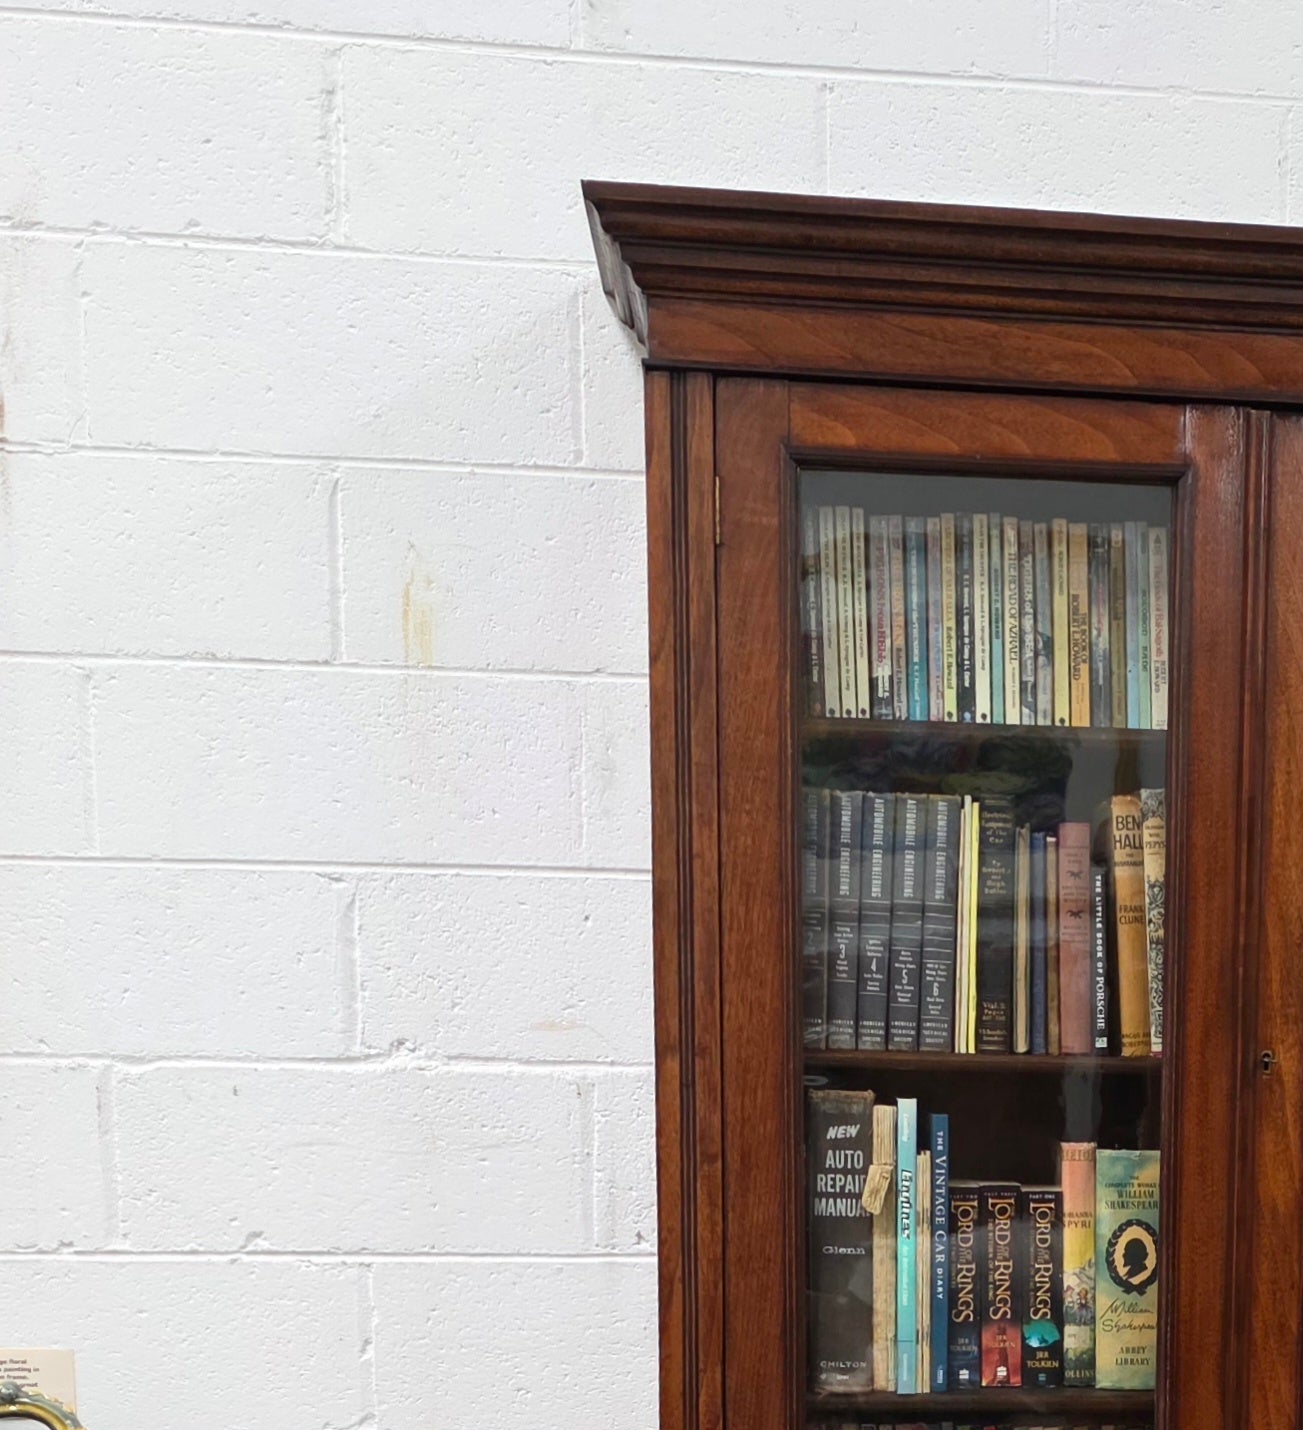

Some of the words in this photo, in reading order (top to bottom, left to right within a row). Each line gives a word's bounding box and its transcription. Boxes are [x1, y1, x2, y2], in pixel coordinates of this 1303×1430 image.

[1008, 552, 1018, 577] THE
[1155, 565, 1163, 580] The
[1024, 554, 1033, 601] TIGERS
[1008, 577, 1018, 606] ROAD
[1009, 606, 1018, 622] OF
[1024, 602, 1034, 614] of
[1072, 594, 1081, 630] ROBERT
[1156, 603, 1163, 613] of
[1025, 614, 1034, 634] the
[946, 626, 955, 651] Robert
[1009, 622, 1019, 664] AZRAEL
[1025, 634, 1035, 659] SEA
[947, 652, 955, 661] E.
[1073, 637, 1081, 681] HOWARD
[1081, 653, 1088, 665] OF
[946, 661, 955, 690] Howard
[840, 797, 851, 844] AUTOMOBILE
[872, 798, 885, 845] AUTOMOBILE
[904, 799, 917, 846] AUTOMOBILE
[936, 801, 948, 848] AUTOMOBILE
[1115, 815, 1141, 832] BEN
[1112, 834, 1144, 850] HALL
[839, 847, 851, 896] ENGINEERING
[871, 849, 883, 898] ENGINEERING
[903, 849, 915, 898] ENGINEERING
[934, 851, 946, 900] ENGINEERING
[1118, 904, 1144, 914] FRANK
[1119, 915, 1144, 926] CLUNE
[838, 944, 845, 959] 3
[871, 957, 877, 972] 4
[902, 969, 908, 984] 5
[1097, 962, 1104, 974] OF
[933, 982, 939, 997] 6
[1096, 976, 1106, 1030] PORSCHE
[826, 1123, 861, 1141] NEW
[824, 1150, 864, 1169] AUTO
[936, 1155, 947, 1225] VINTAGE
[1116, 1189, 1154, 1199] WILLIAM
[813, 1197, 871, 1217] MANUA
[900, 1168, 913, 1241] Engines
[1104, 1199, 1159, 1210] SHAKESPEAR
[951, 1200, 978, 1247] LORD
[988, 1198, 1015, 1245] LORD
[1029, 1202, 1056, 1247] LORD
[822, 1246, 866, 1255] Glenn
[935, 1230, 947, 1263] CAR
[936, 1268, 944, 1300] DIARY
[952, 1262, 976, 1323] RINGS
[989, 1258, 1013, 1320] RINGS
[1030, 1263, 1053, 1320] RINGS
[1115, 1357, 1151, 1366] LIBRARY
[1119, 1345, 1147, 1354] ABBEY
[819, 1360, 868, 1369] CHILTON
[1026, 1360, 1060, 1368] TOLKIEN
